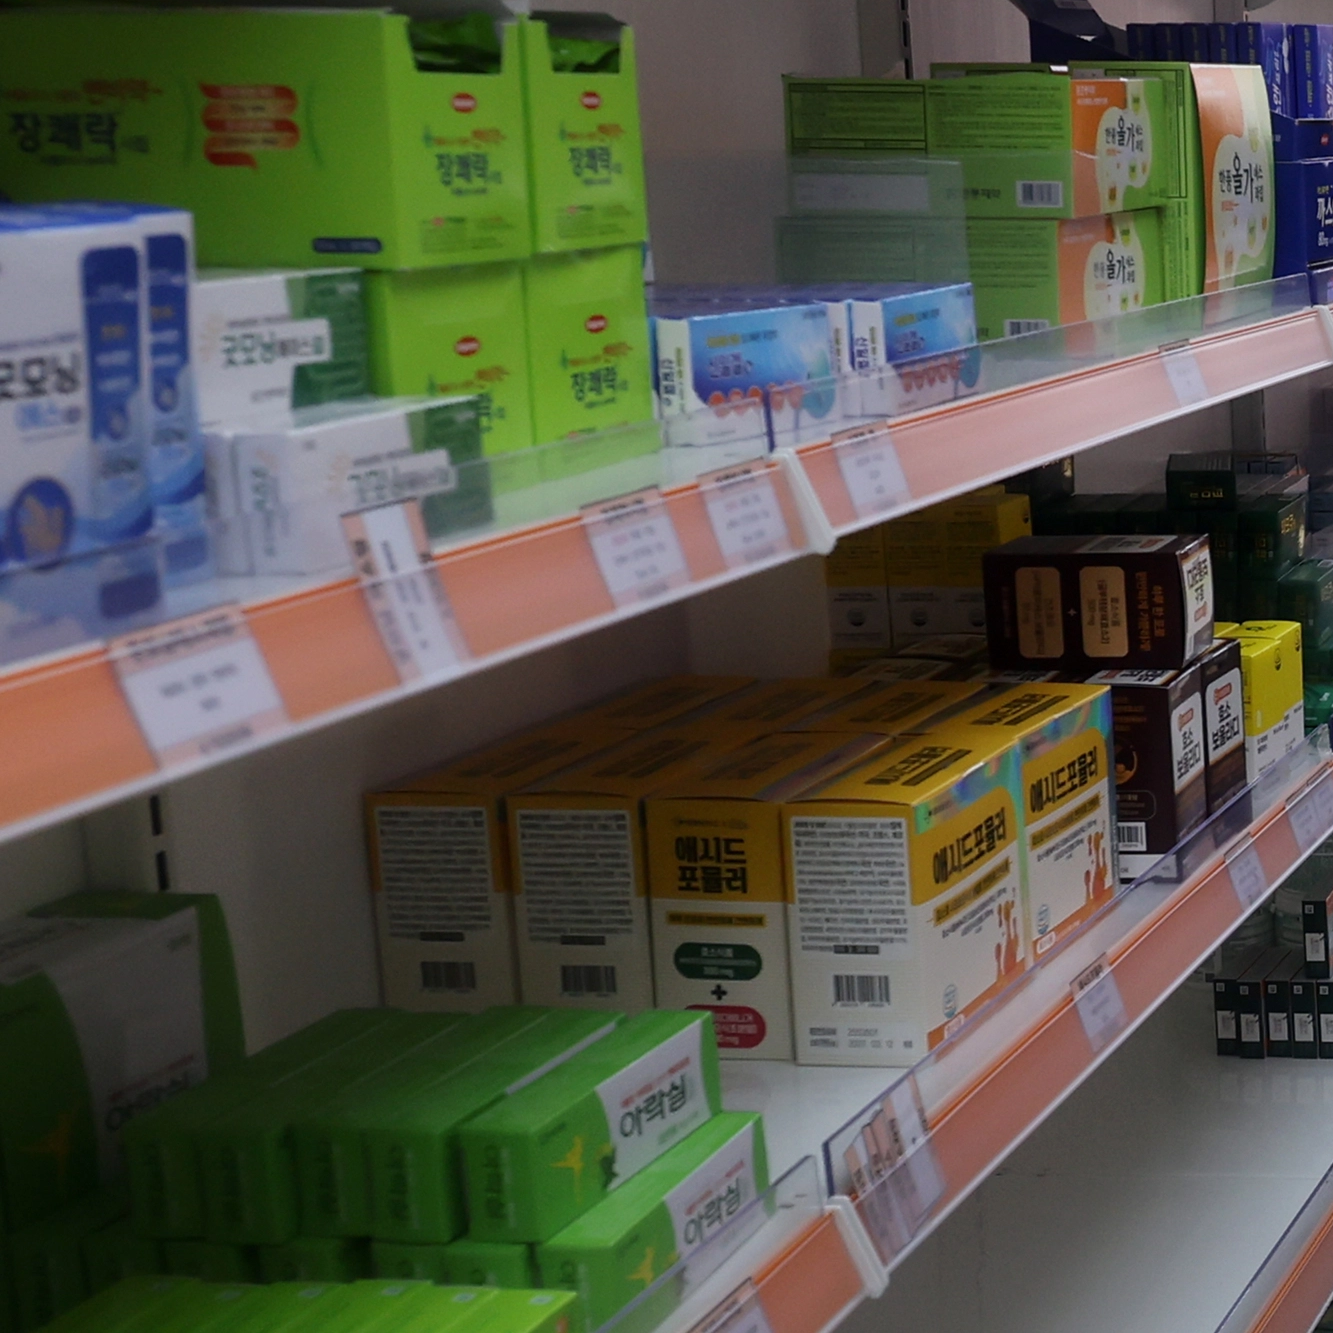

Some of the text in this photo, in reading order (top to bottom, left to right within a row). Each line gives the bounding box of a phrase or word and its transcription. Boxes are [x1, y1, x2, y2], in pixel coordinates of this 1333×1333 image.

[1232, 151, 1254, 205] 올가
[674, 836, 747, 865] 애시드
[677, 866, 748, 895] 포뮬러
[619, 1071, 689, 1140] 아락실
